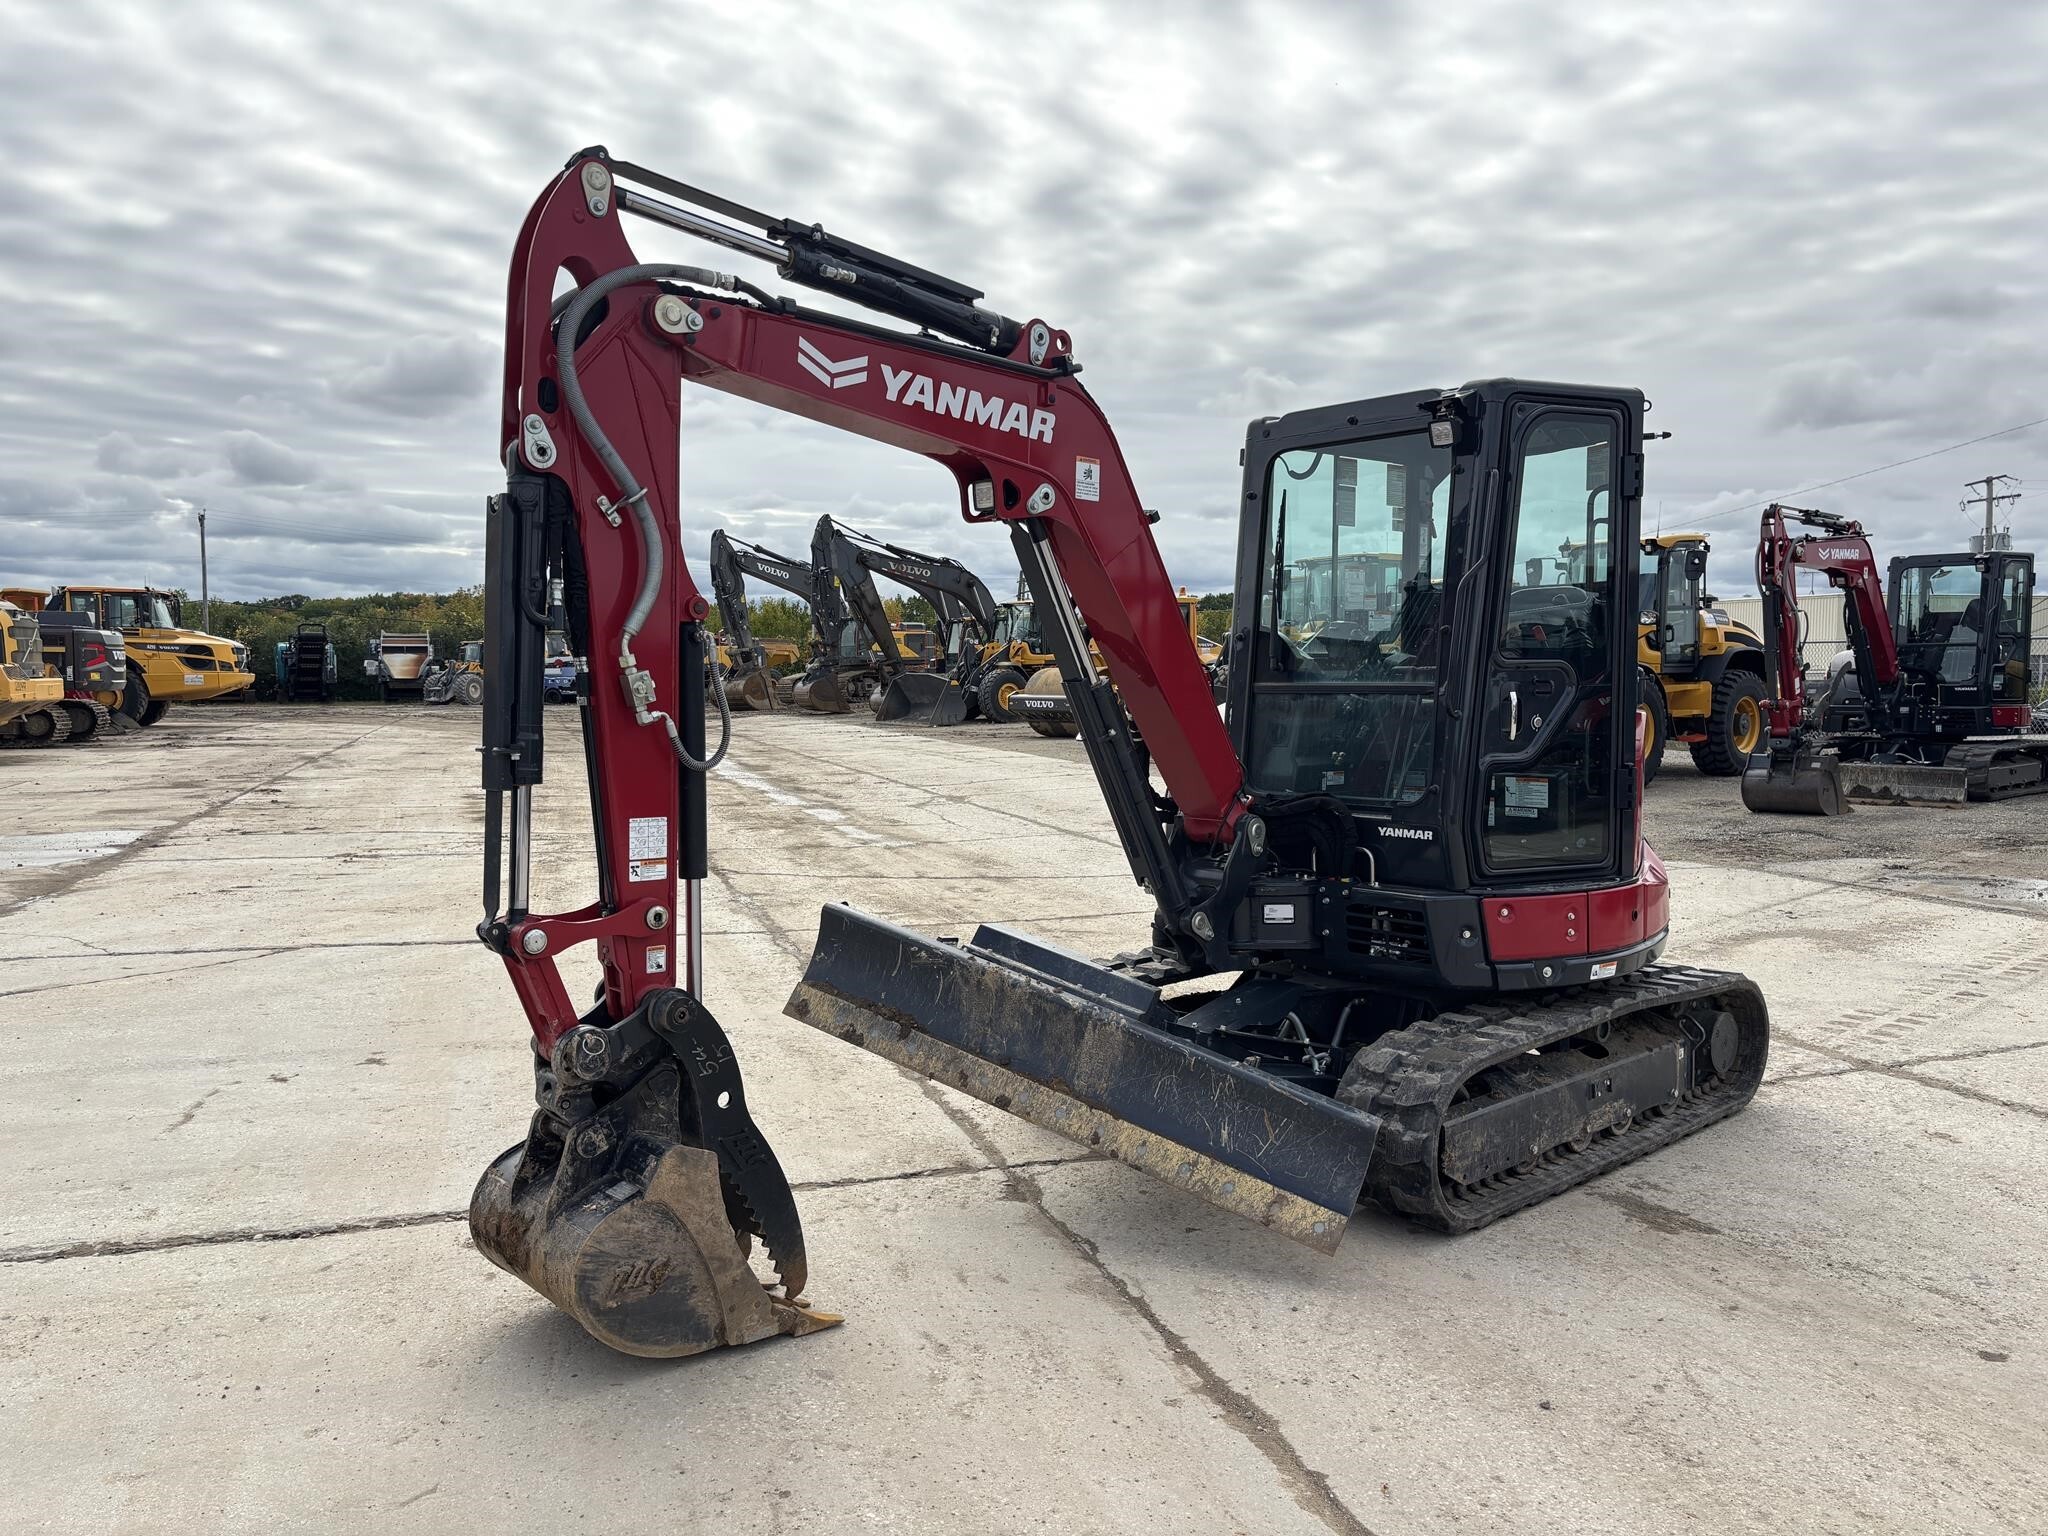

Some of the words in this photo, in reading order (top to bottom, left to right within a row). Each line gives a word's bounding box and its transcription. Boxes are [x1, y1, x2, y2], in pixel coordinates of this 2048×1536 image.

[880, 363, 1056, 444] YANMAR
[1830, 548, 1860, 560] YANMAR
[757, 562, 790, 580] VOLVO
[888, 561, 932, 578] VOLVO
[1025, 700, 1055, 709] VOLVO
[1377, 826, 1433, 841] YANMAR
